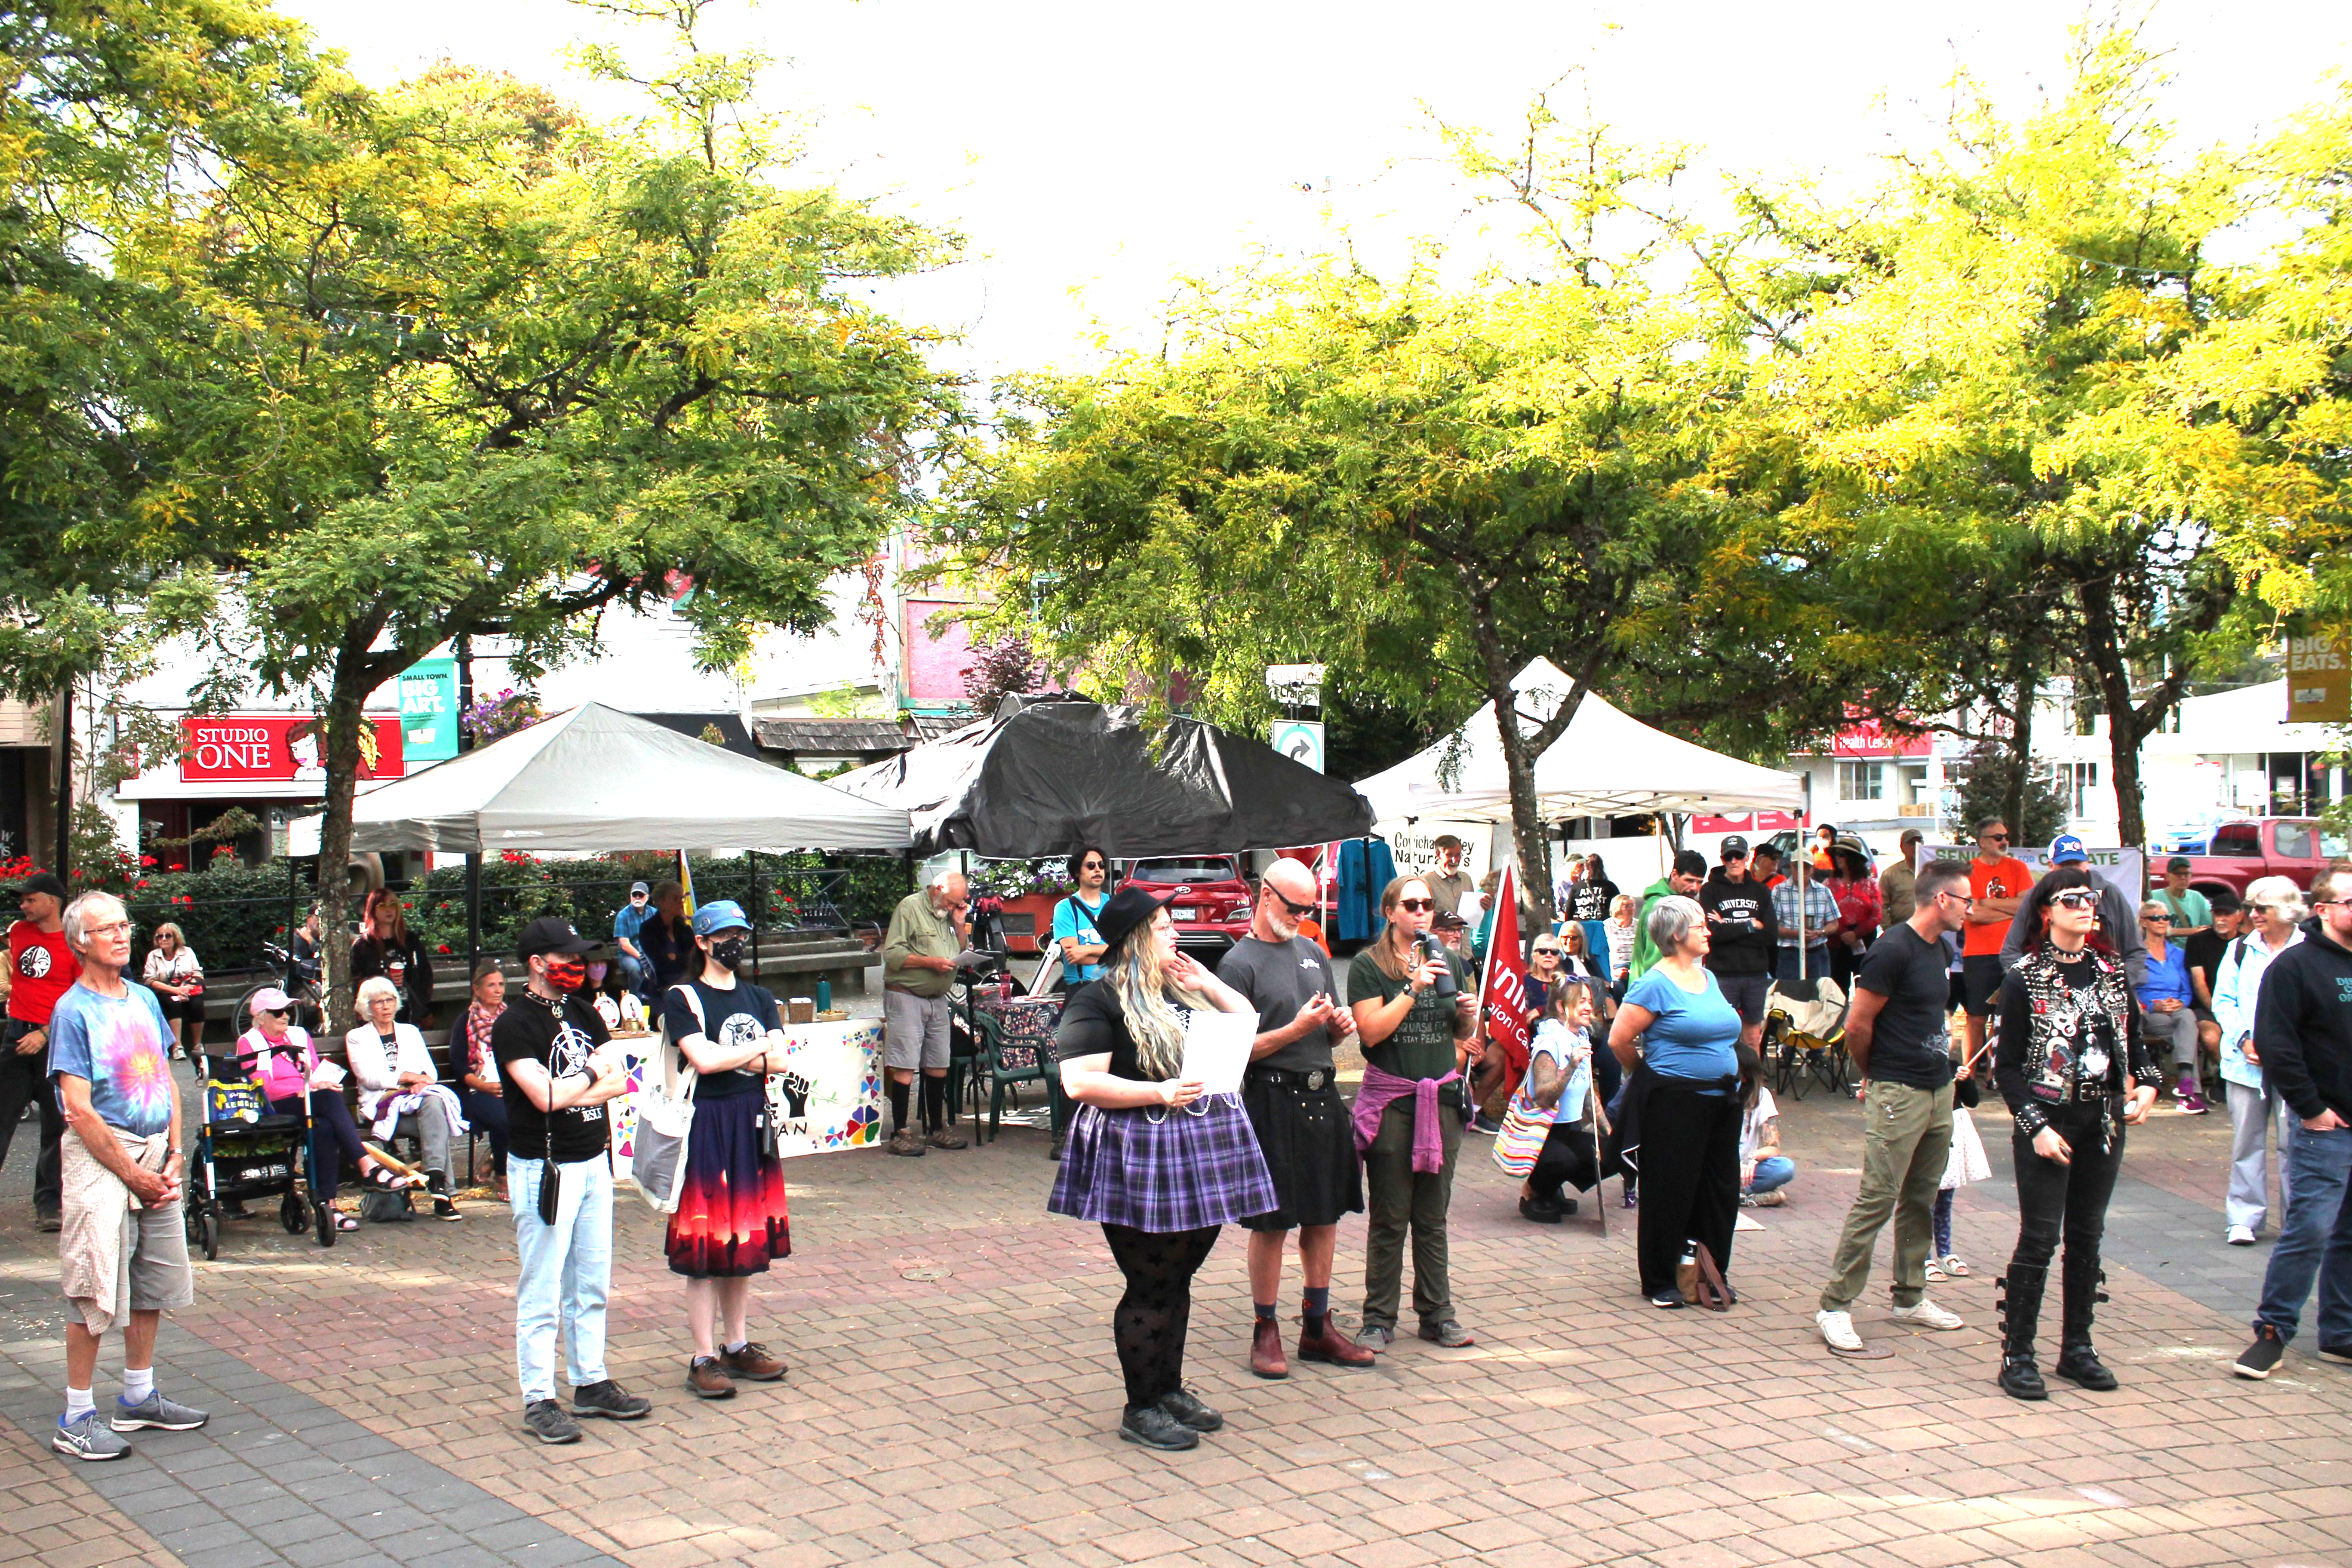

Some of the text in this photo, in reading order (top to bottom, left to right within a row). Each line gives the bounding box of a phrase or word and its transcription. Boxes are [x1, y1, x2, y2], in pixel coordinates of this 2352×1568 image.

[2292, 636, 2331, 654] BIG
[2292, 653, 2347, 671] EATS.
[401, 680, 439, 697] BIG
[402, 696, 445, 714] ART.
[197, 728, 269, 742] STUDIO
[1839, 734, 1865, 749] Health
[196, 744, 270, 769] ONE
[2018, 854, 2036, 863] FOR
[2038, 852, 2120, 866] CATE
